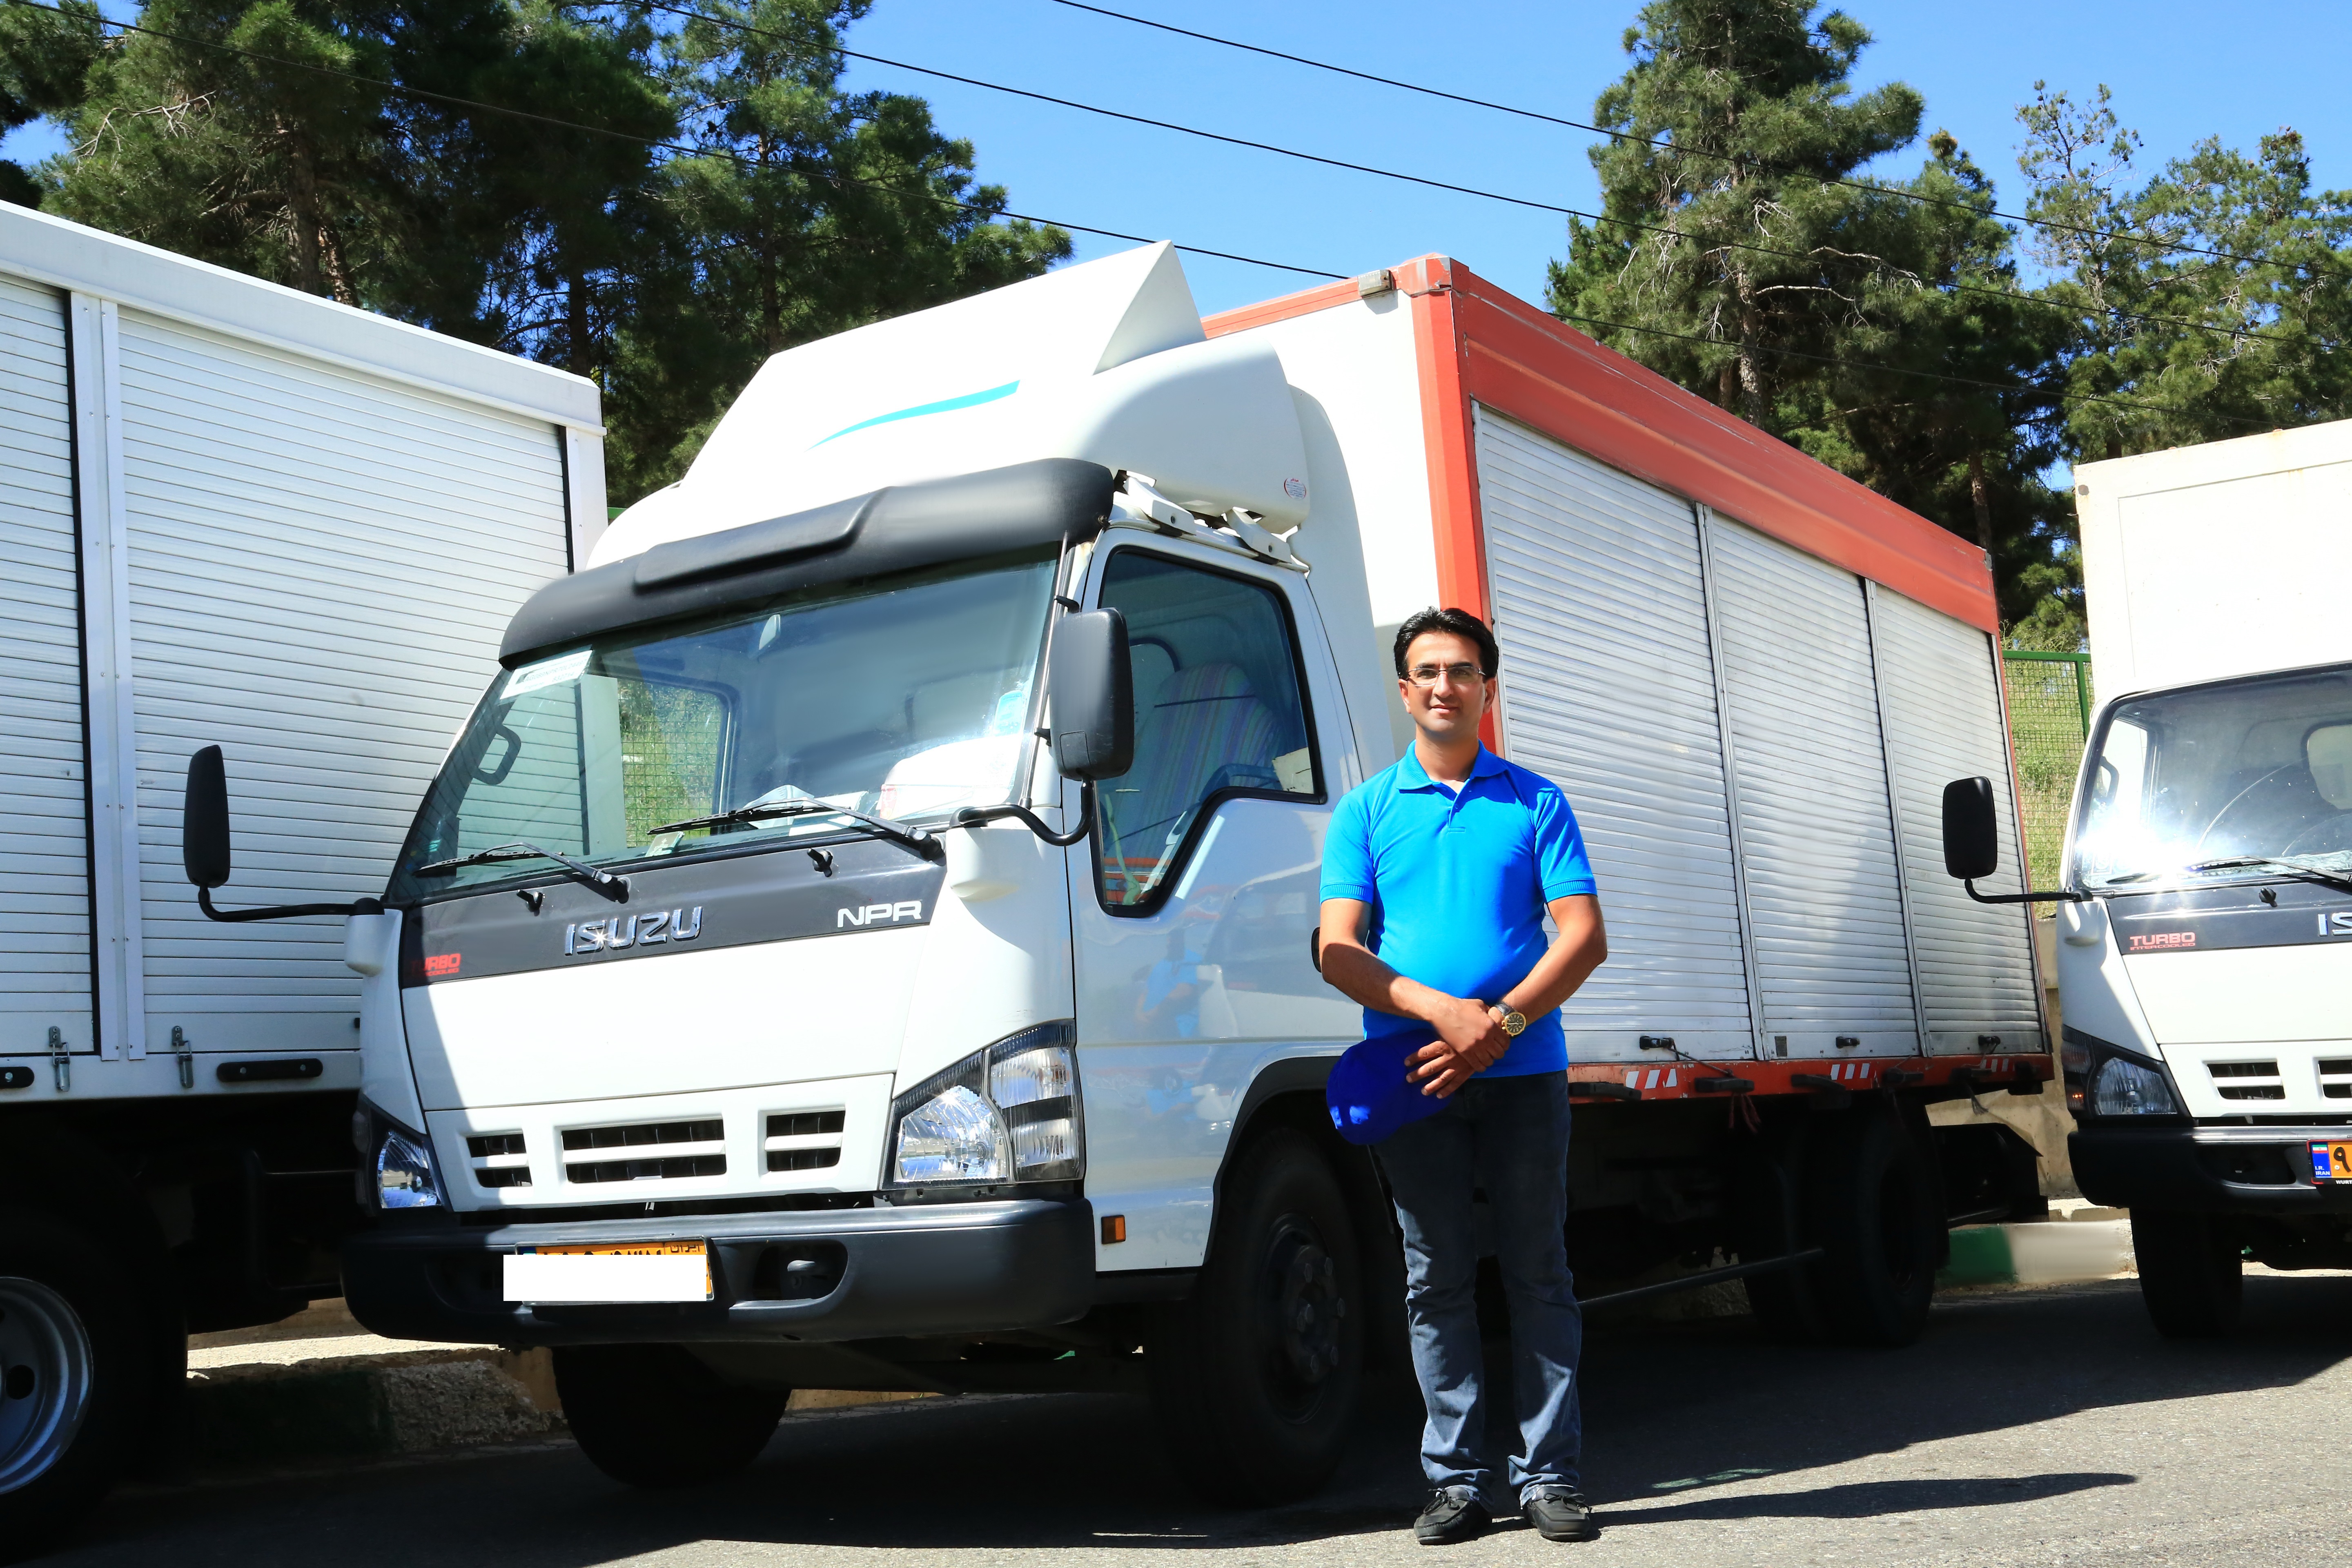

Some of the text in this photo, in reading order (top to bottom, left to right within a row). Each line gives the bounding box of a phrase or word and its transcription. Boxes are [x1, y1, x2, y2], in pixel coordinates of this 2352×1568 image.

[837, 900, 922, 928] NPR
[565, 906, 702, 956] ISUZU
[2130, 932, 2196, 946] TURBO
[2130, 942, 2196, 951] INTERCOOLED
[670, 1244, 700, 1253] ایران
